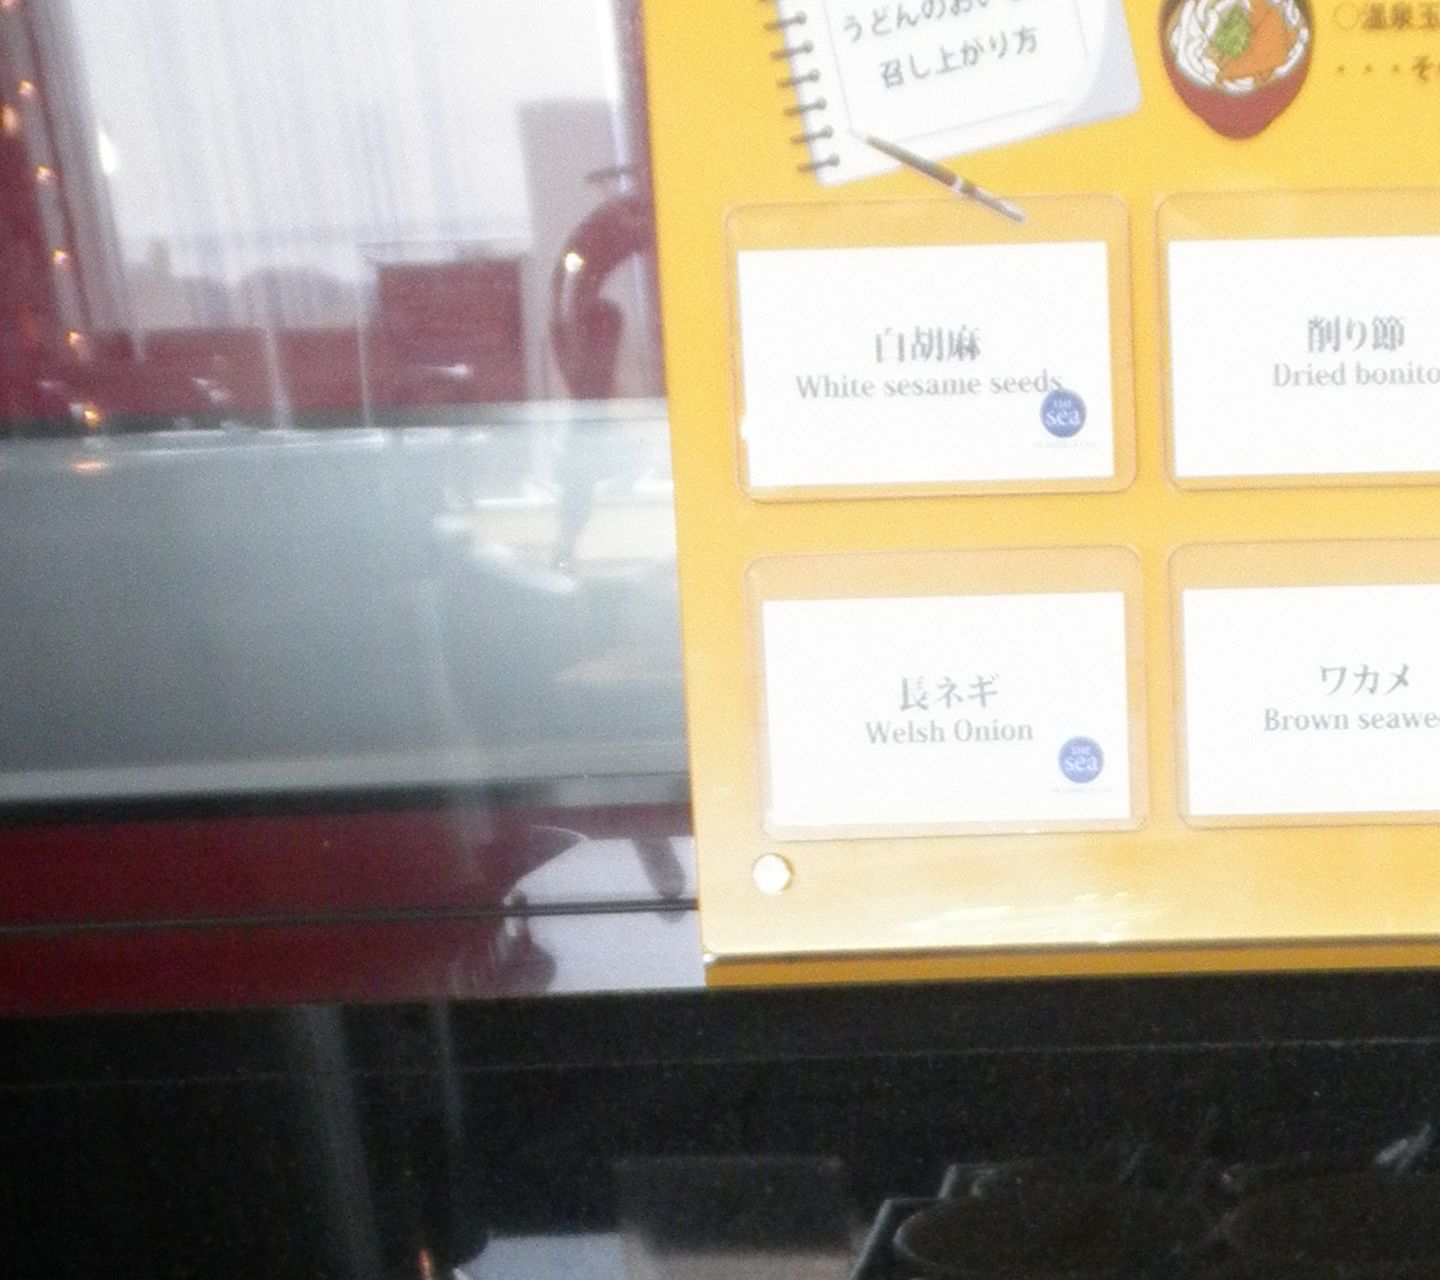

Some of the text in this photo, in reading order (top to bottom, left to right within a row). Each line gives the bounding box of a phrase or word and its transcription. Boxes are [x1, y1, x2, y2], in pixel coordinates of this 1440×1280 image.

[843, 0, 1022, 43] うどんのお
[879, 23, 1040, 89] 召し上がり方
[875, 325, 982, 364] 白胡麻
[1307, 314, 1406, 354] 削り節
[796, 369, 1063, 399] White sesame seeds
[1272, 363, 1347, 388] Dried
[1046, 409, 1081, 427] sea
[900, 673, 1001, 712] 長ネギ
[1319, 663, 1411, 696] ワカメ
[865, 718, 1033, 744] Welsh Onion
[1263, 707, 1350, 731] Brown
[1064, 755, 1099, 773] sea
